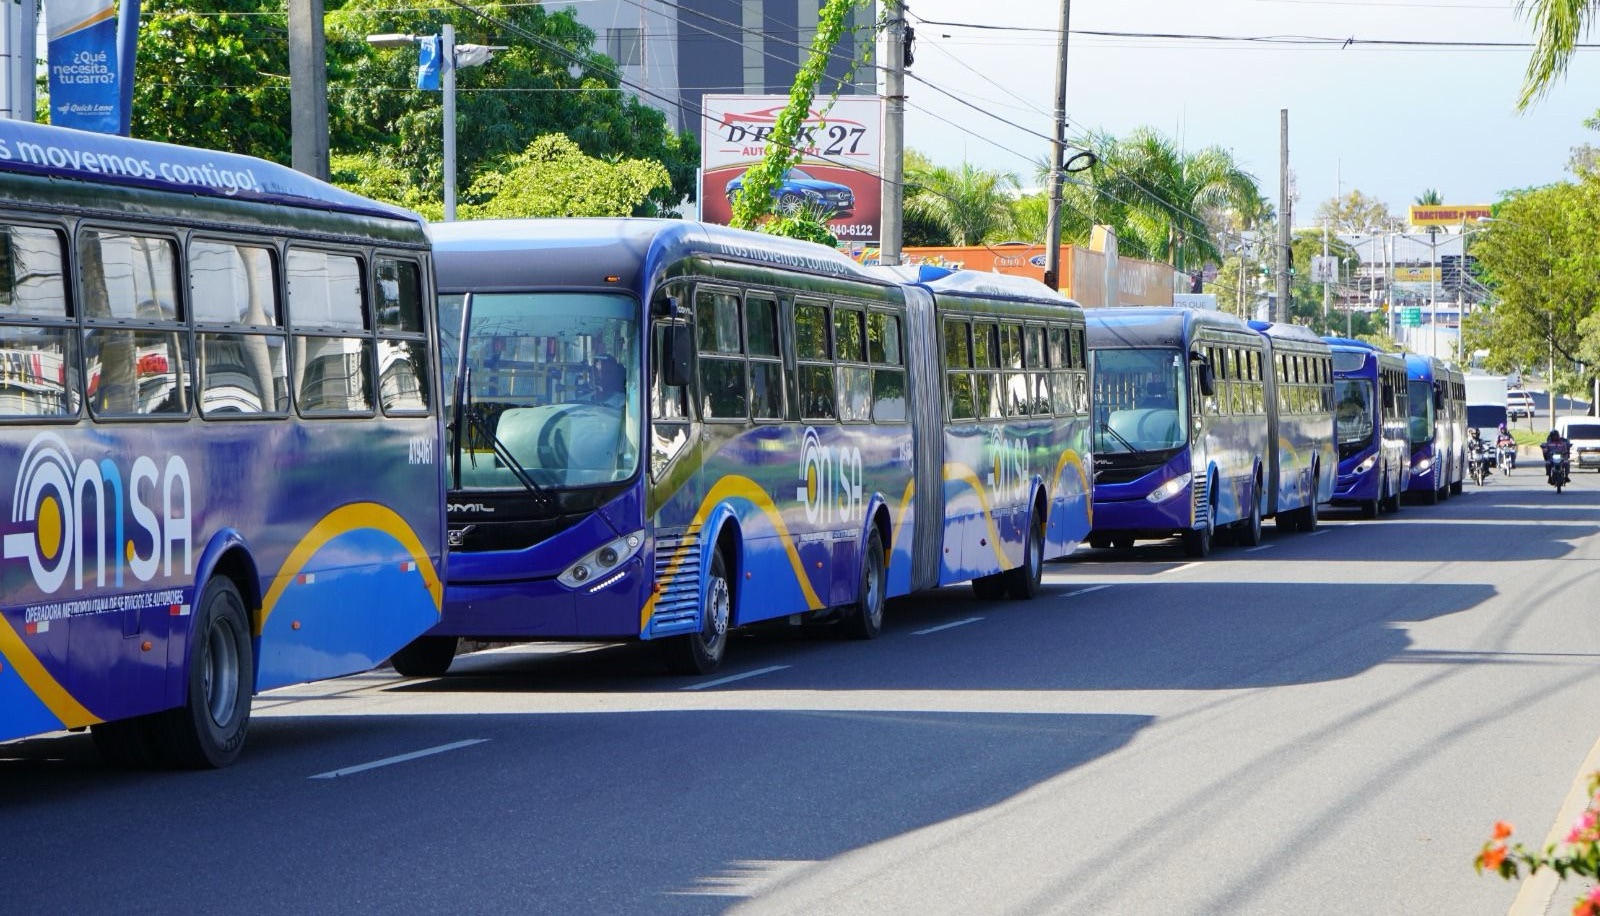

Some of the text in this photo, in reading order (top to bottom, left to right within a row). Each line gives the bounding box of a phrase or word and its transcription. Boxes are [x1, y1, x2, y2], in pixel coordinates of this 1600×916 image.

[73, 50, 107, 64] ¿Qué
[53, 62, 107, 74] necesita
[59, 73, 115, 84] tu carro?
[70, 104, 92, 112] Quick
[823, 125, 867, 156] 27
[16, 140, 157, 180] movemos
[159, 161, 262, 196] contigo!
[750, 247, 805, 268] movemos
[25, 603, 62, 624] OPERADORA
